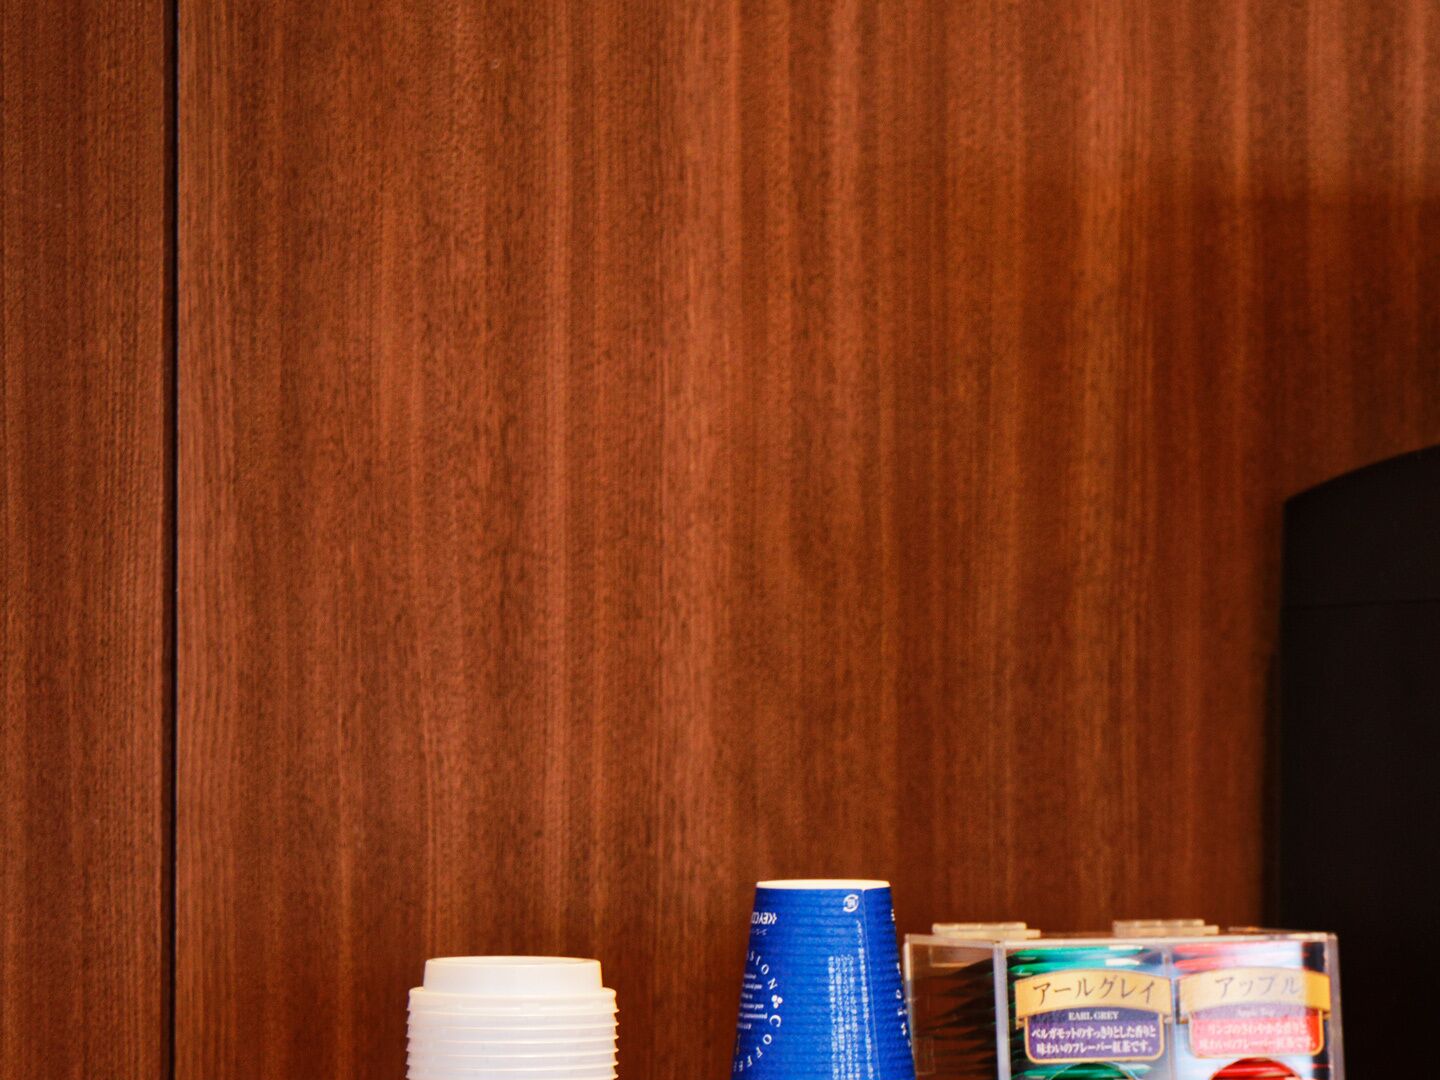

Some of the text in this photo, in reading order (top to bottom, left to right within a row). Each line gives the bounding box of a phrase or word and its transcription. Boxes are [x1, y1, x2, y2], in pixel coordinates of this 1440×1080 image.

[1033, 976, 1155, 1005] アールグレイ
[1215, 975, 1301, 999] アップル
[1068, 1011, 1119, 1021] EARL GREY
